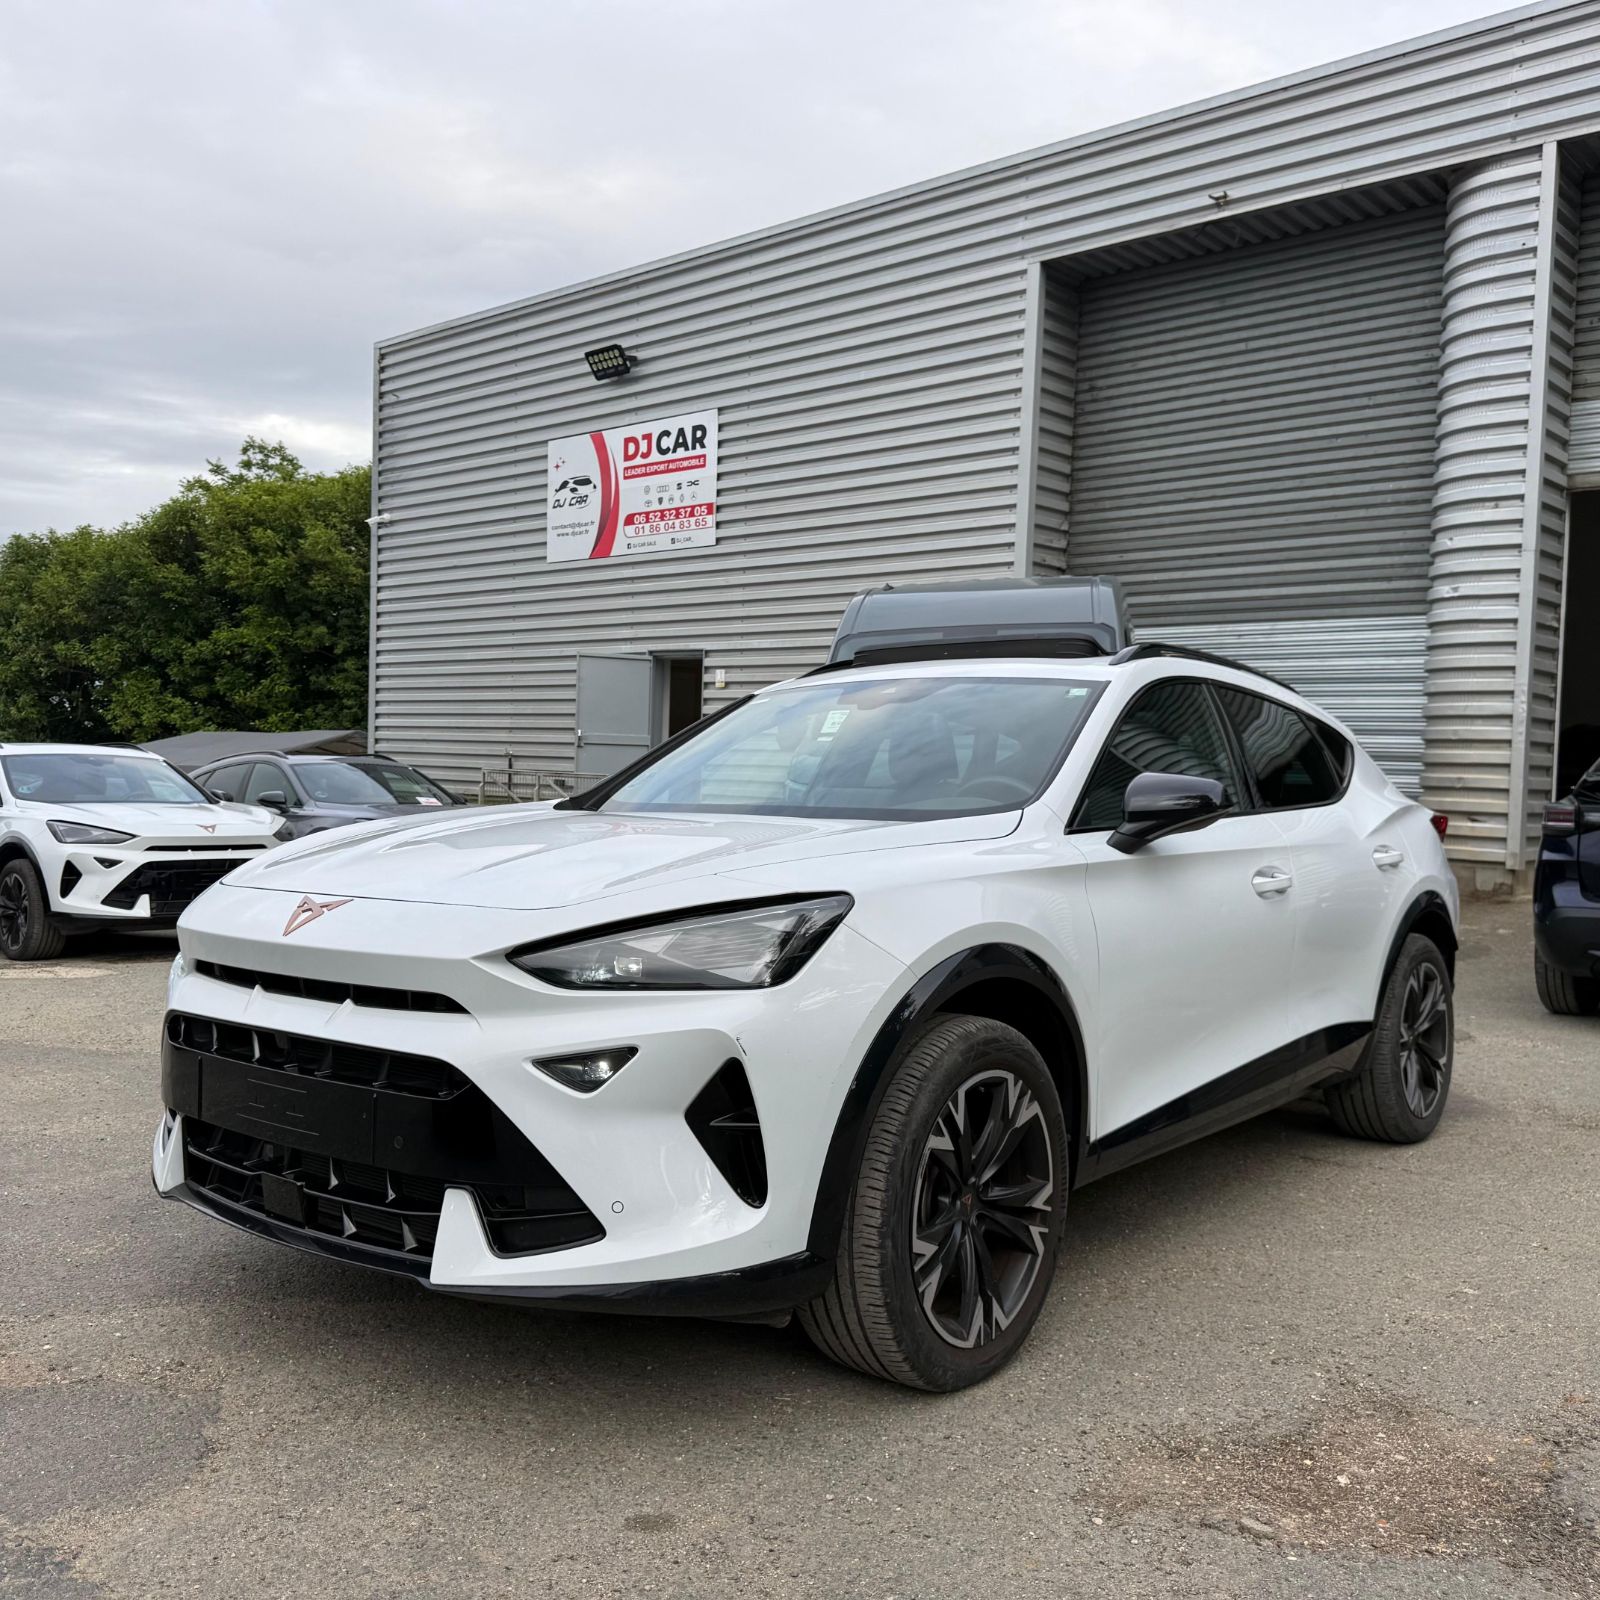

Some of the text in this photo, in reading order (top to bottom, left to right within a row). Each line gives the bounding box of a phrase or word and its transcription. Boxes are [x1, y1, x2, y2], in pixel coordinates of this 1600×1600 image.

[624, 424, 707, 462] DJ CAR
[624, 458, 704, 476] LEADER EXPORT AUTOMOBILE
[552, 498, 566, 509] DJ
[634, 506, 708, 524] 06 52 32 37 05
[634, 517, 707, 535] 01 86 04 83 65
